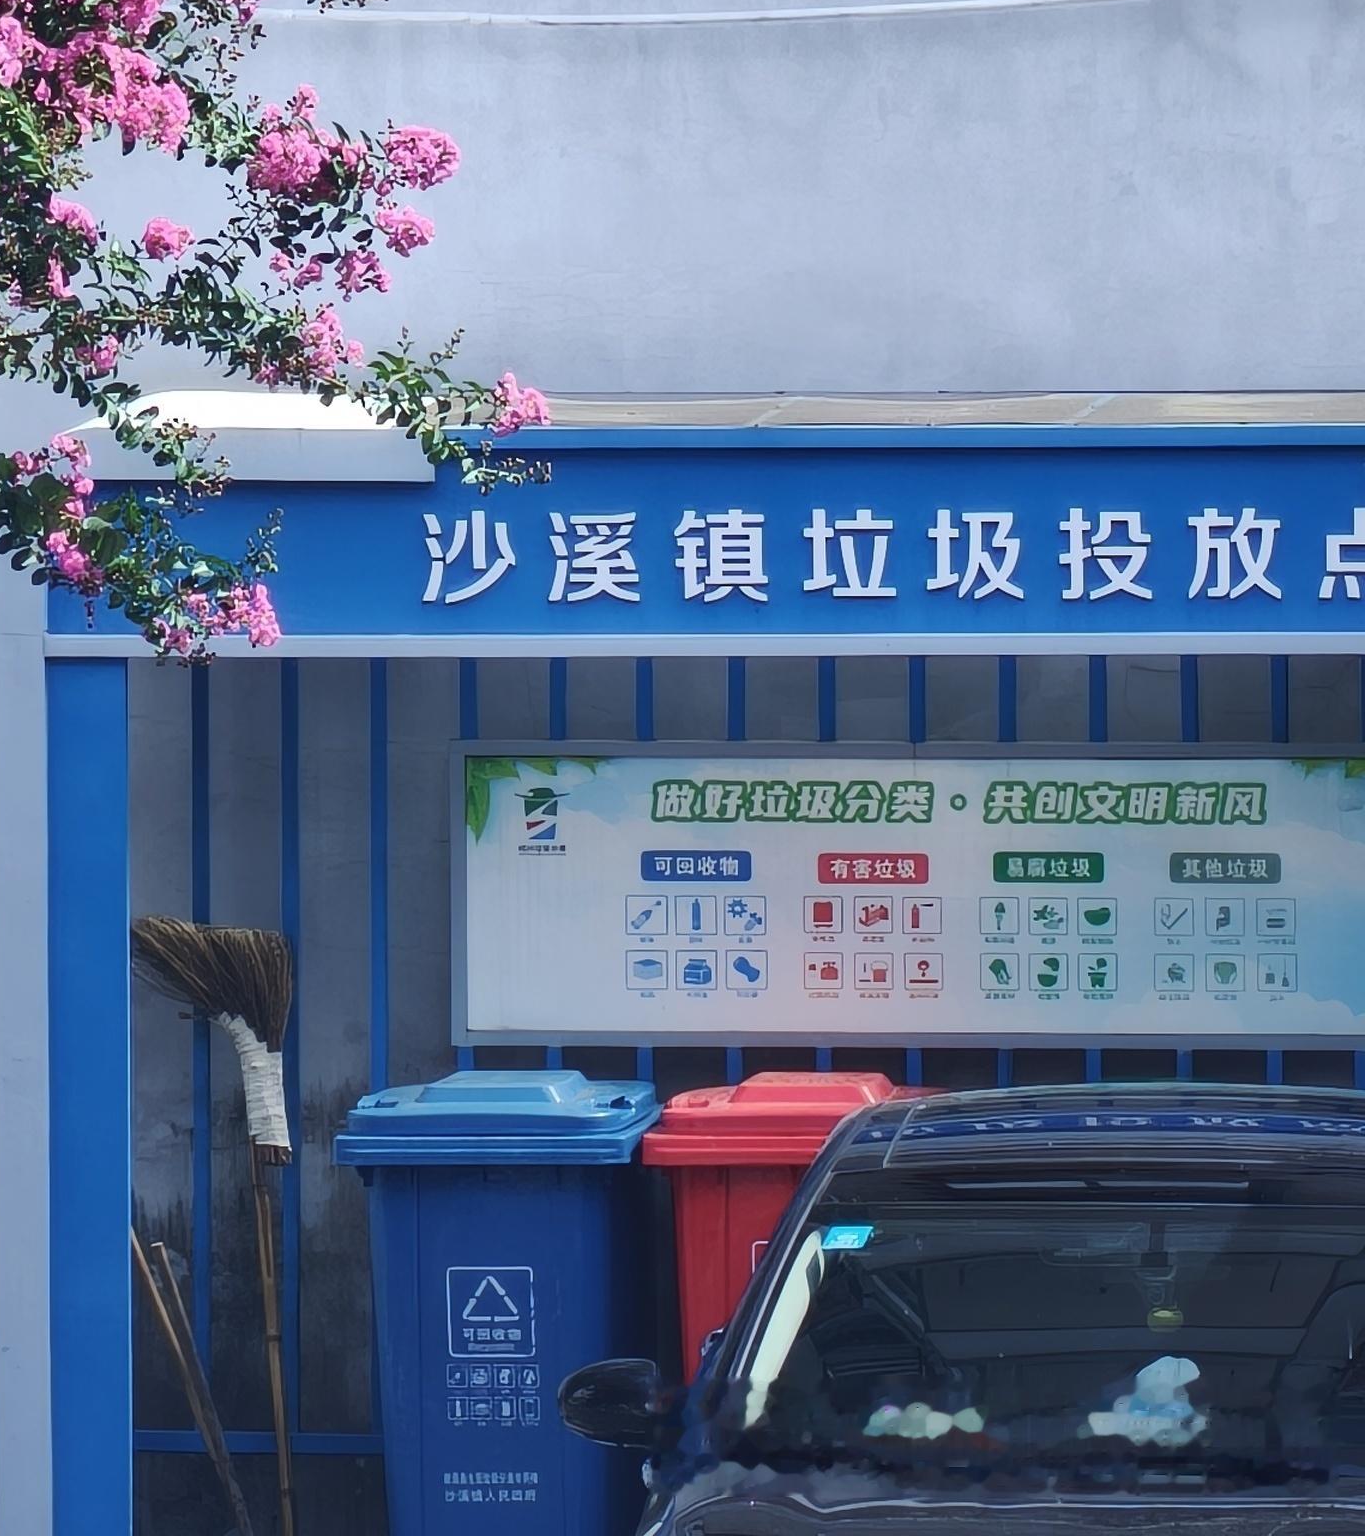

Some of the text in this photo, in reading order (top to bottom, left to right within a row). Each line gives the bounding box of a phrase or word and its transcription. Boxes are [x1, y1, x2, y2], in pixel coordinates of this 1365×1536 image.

[654, 855, 739, 877] 可回收物
[830, 859, 917, 880] 有害垃圾
[1182, 858, 1269, 879] 其他垃圾
[462, 1328, 522, 1341] 可回
